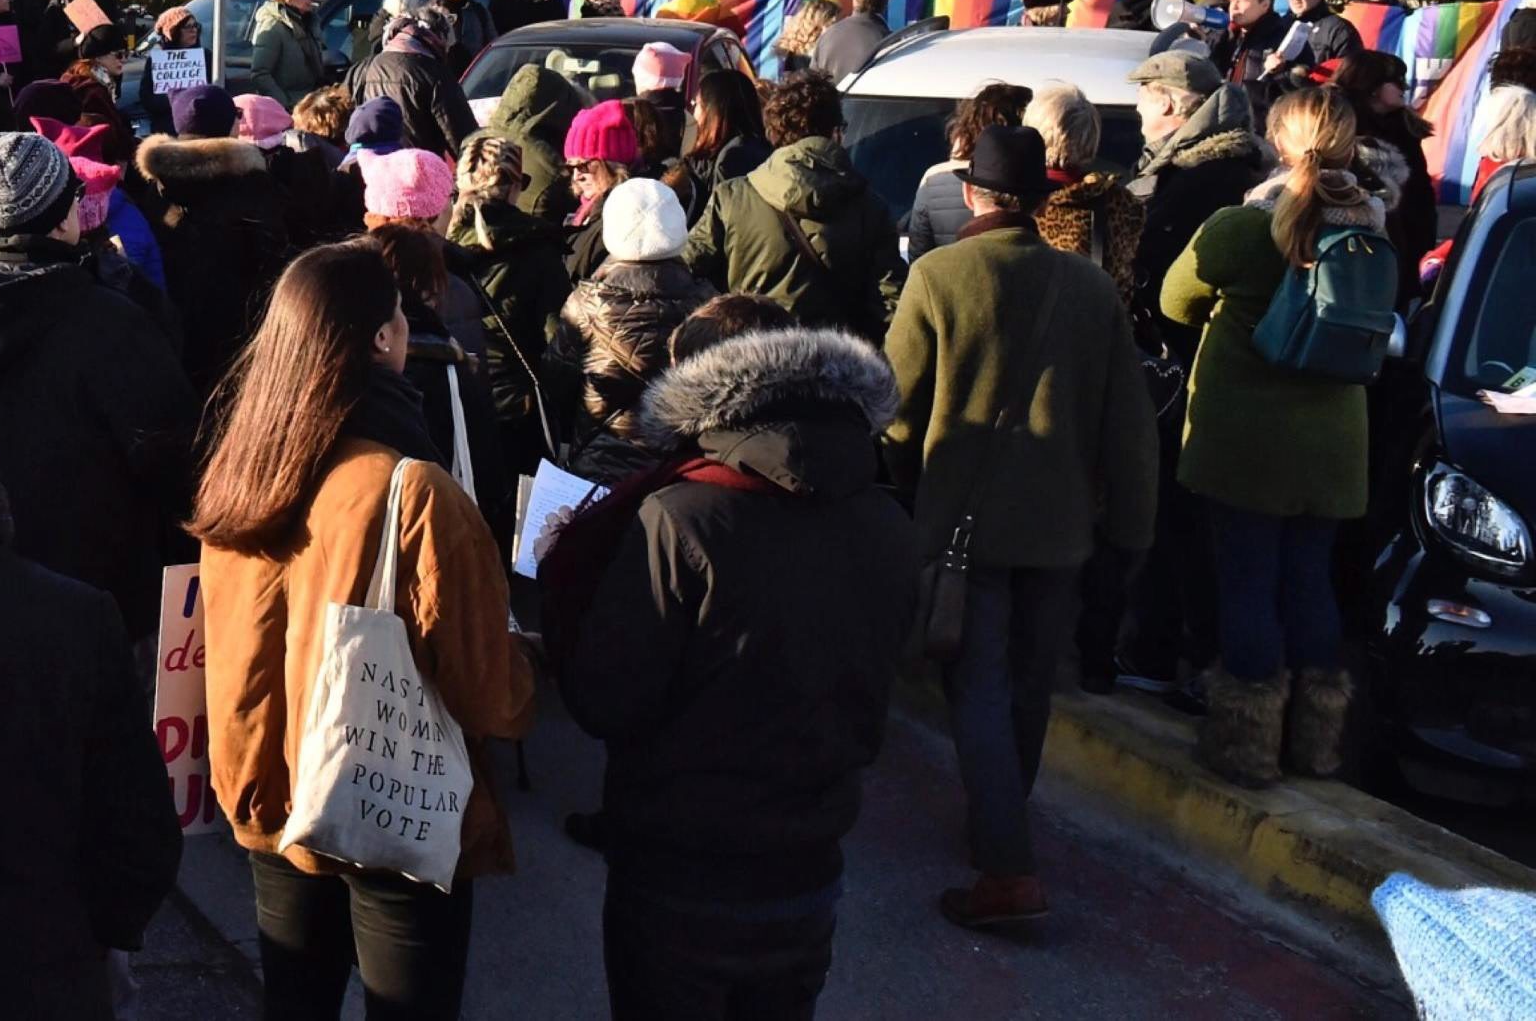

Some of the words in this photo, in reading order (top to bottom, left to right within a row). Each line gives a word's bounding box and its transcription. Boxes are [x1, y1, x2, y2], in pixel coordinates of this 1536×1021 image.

[152, 59, 204, 71] ELECTORAL
[156, 68, 201, 81] COLLEGE
[167, 50, 189, 61] THE
[164, 628, 206, 673] de
[360, 661, 425, 707] NAST
[345, 724, 398, 761] WIN
[410, 748, 446, 776] THE
[351, 762, 460, 813] POPULAR
[359, 798, 432, 841] VOTE
